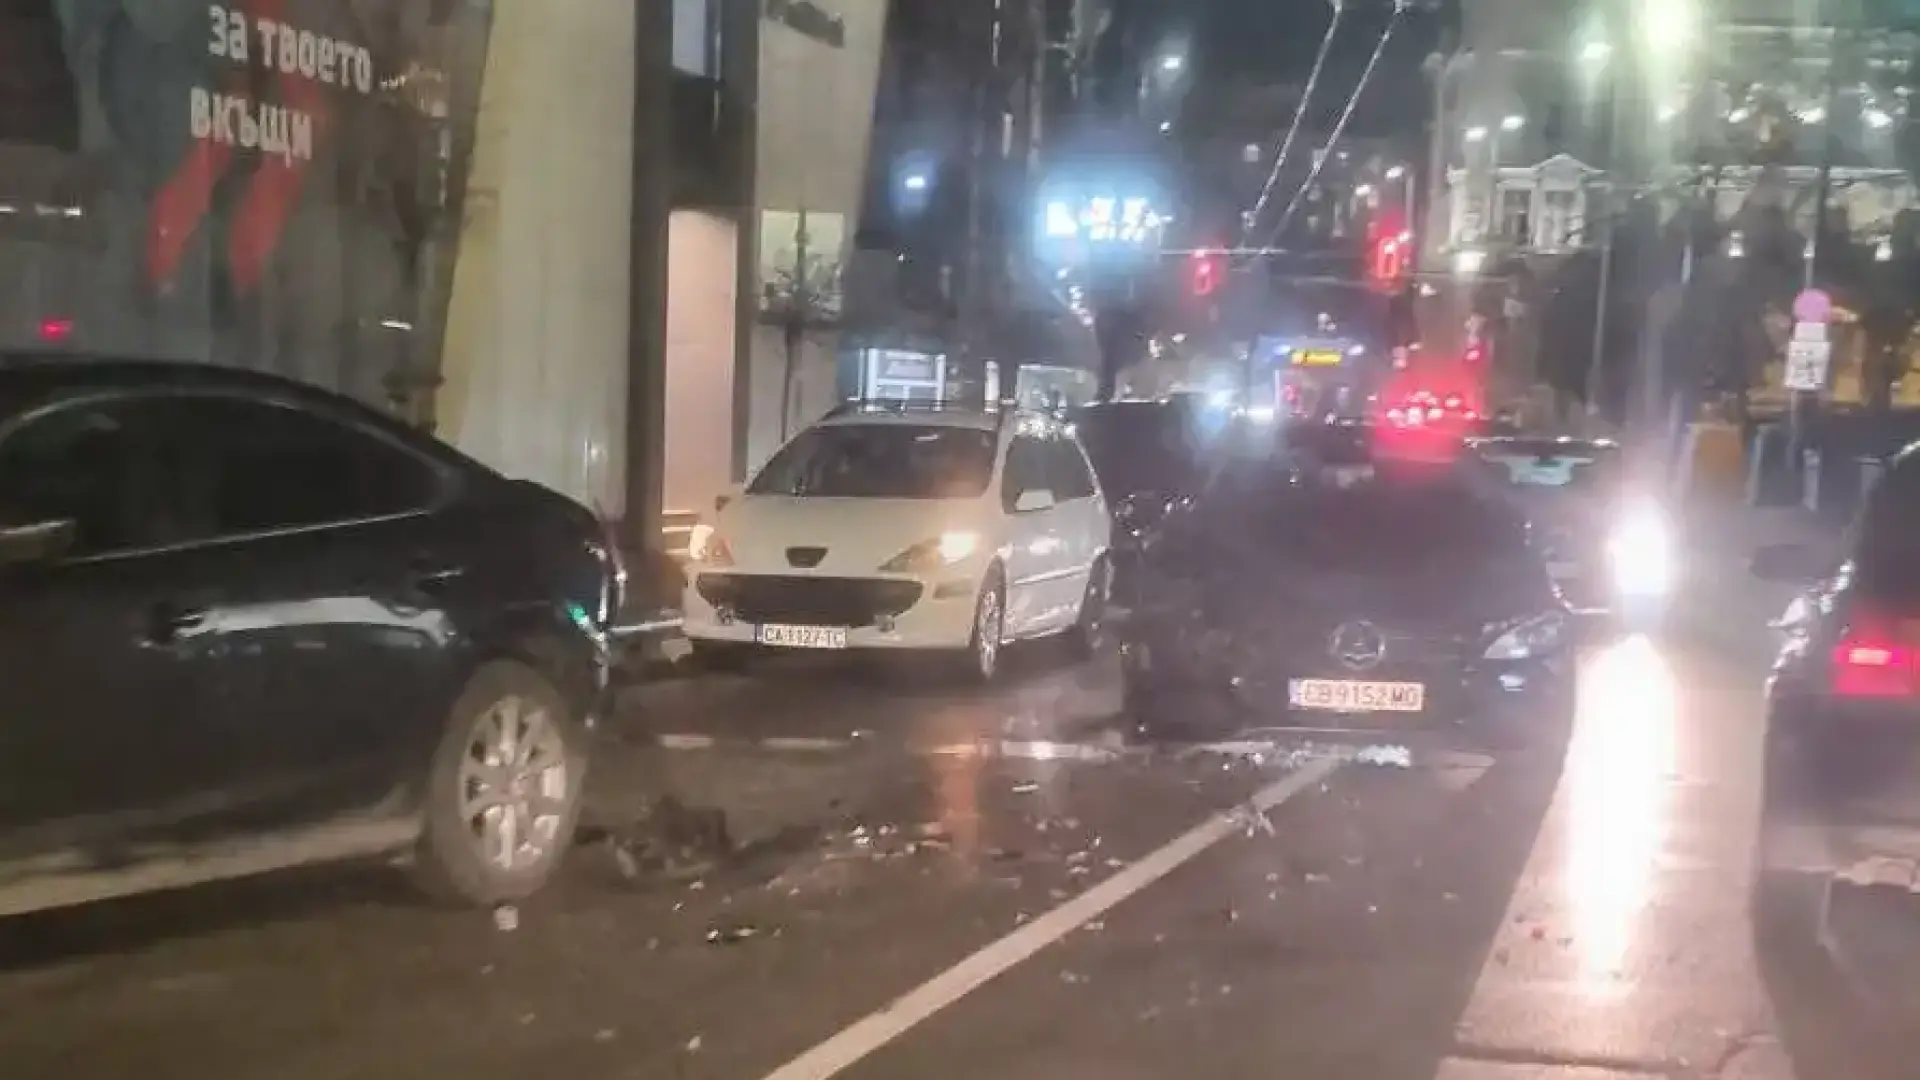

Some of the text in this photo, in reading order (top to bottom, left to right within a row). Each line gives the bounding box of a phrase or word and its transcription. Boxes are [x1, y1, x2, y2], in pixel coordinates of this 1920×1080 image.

[208, 5, 371, 94] за твоето
[190, 86, 313, 168] вкъщи
